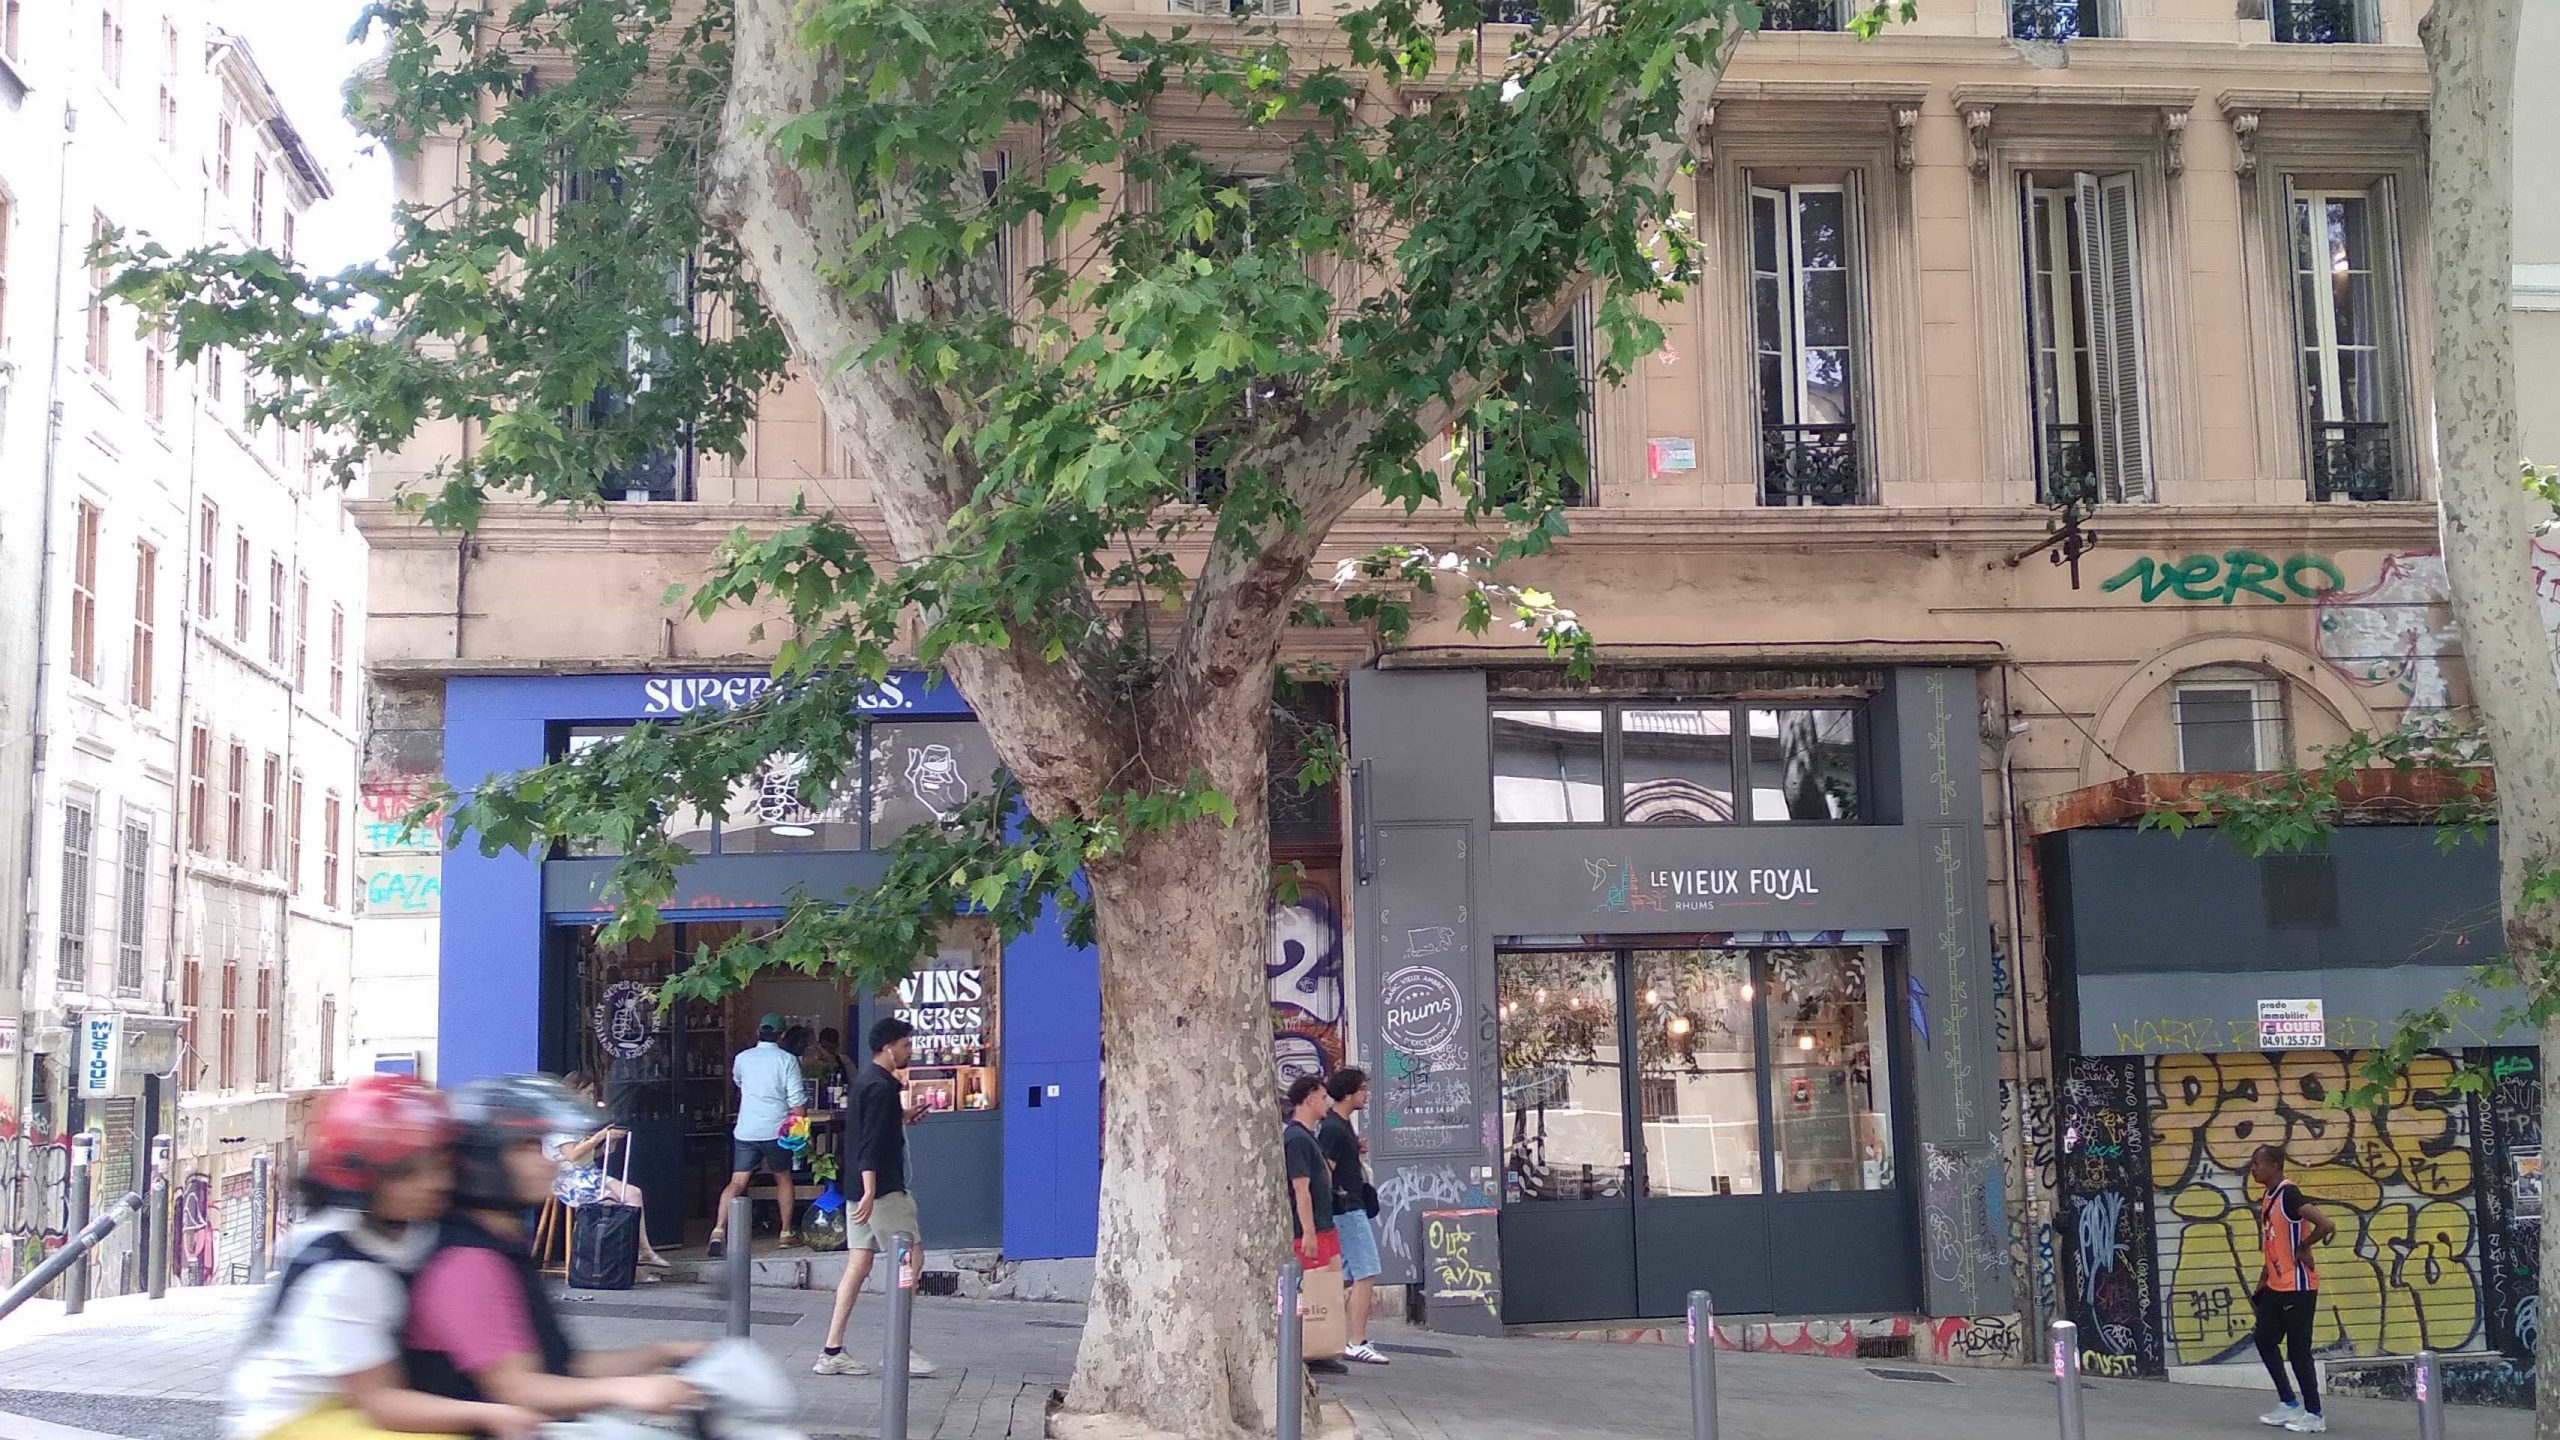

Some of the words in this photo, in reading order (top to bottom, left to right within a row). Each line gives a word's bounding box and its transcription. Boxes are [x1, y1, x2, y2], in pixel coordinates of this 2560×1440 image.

[368, 872, 441, 903] GAZA
[1651, 871, 1669, 887] LE
[1671, 869, 1739, 895] VIEUX
[1750, 869, 1819, 900] FOYAL
[1675, 900, 1715, 911] RHUMS
[899, 969, 982, 1003] VINS
[894, 1006, 982, 1030] BIERES
[1387, 997, 1452, 1030] Rhums
[2260, 1001, 2287, 1011] prado
[2261, 1011, 2309, 1020] immobilier
[2276, 1021, 2321, 1033] LOUER
[2262, 1035, 2322, 1046] 04.91.25.57.57
[89, 1021, 113, 1089] MUSIQUE
